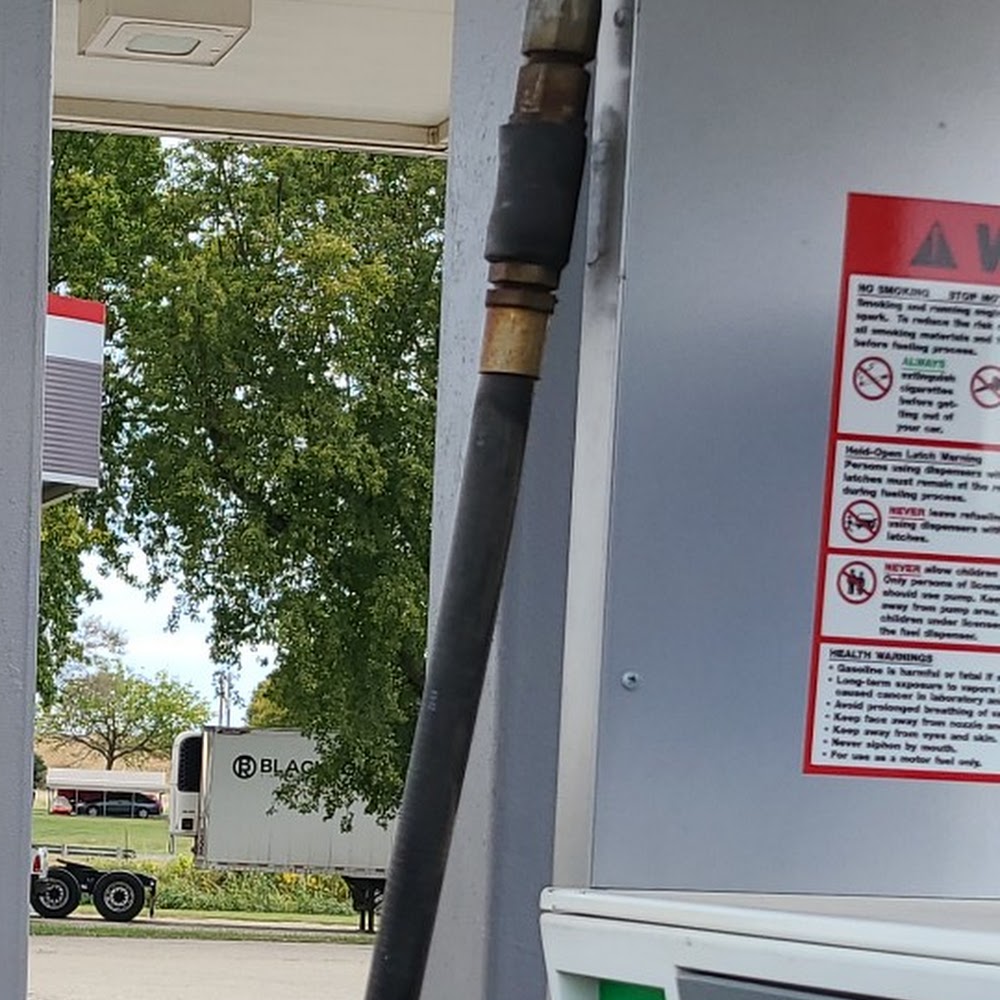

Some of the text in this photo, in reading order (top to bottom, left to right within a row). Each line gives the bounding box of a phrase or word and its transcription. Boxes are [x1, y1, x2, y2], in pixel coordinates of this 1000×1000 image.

[858, 283, 874, 294] NO
[878, 285, 930, 297] SMOKING
[948, 291, 977, 301] STOP
[857, 298, 902, 311] Smoking
[907, 304, 926, 312] and
[930, 306, 970, 316] running
[872, 328, 916, 340] smoking
[853, 338, 888, 349] before
[902, 357, 945, 369] ALWAYS
[899, 396, 933, 407] before
[845, 445, 983, 465] Hold-Open Latch Warning
[844, 460, 887, 471] Persons
[891, 464, 921, 475] using
[924, 466, 982, 477] dispensers
[843, 473, 882, 484] latches
[887, 478, 913, 486] must
[917, 480, 953, 489] remain
[957, 482, 968, 490] at
[972, 482, 988, 491] the
[842, 486, 877, 498] during
[881, 490, 917, 501] fueling
[889, 506, 925, 516] NEVER
[929, 507, 956, 518] leave
[888, 521, 918, 532] using
[920, 522, 977, 533] dispensers
[885, 563, 998, 577] NEVER allow children
[883, 575, 906, 586] Only
[911, 578, 953, 588] persons
[957, 580, 967, 589] of
[882, 589, 918, 599] should
[921, 592, 940, 600] use
[881, 603, 908, 613] away
[912, 603, 936, 612] from
[940, 606, 970, 616] pump
[880, 614, 923, 625] children
[927, 615, 959, 626] under
[880, 627, 897, 636] the
[900, 628, 921, 637] fuel
[829, 649, 933, 663] HEALTH WARNINGS
[837, 664, 883, 675] Gasoline
[887, 666, 896, 675] is
[900, 668, 940, 678] harmful
[944, 671, 955, 679] or
[958, 670, 982, 680] fatal
[836, 676, 996, 694] Long-term exposure to vapors
[835, 689, 873, 699] caused
[877, 691, 913, 700] cancer
[917, 692, 926, 701] in
[930, 693, 983, 705] laboratory
[834, 700, 864, 710] Avoid
[867, 702, 921, 714] prolonged
[924, 704, 974, 717] breathing
[978, 708, 988, 717] of
[833, 712, 861, 724] Keep
[864, 714, 888, 724] face
[891, 717, 918, 727] away
[922, 717, 946, 727] from
[949, 720, 983, 730] nozzle
[833, 725, 860, 737] Keep
[864, 728, 890, 739] away
[894, 728, 918, 738] from
[922, 731, 947, 741] eyes
[951, 733, 969, 742] and
[831, 738, 861, 748] Never
[865, 740, 900, 751] siphon
[905, 742, 917, 752] by
[830, 750, 848, 760] For
[852, 753, 870, 761] use
[874, 754, 886, 762] as
[900, 756, 931, 765] motor
[934, 756, 955, 765] fuel
